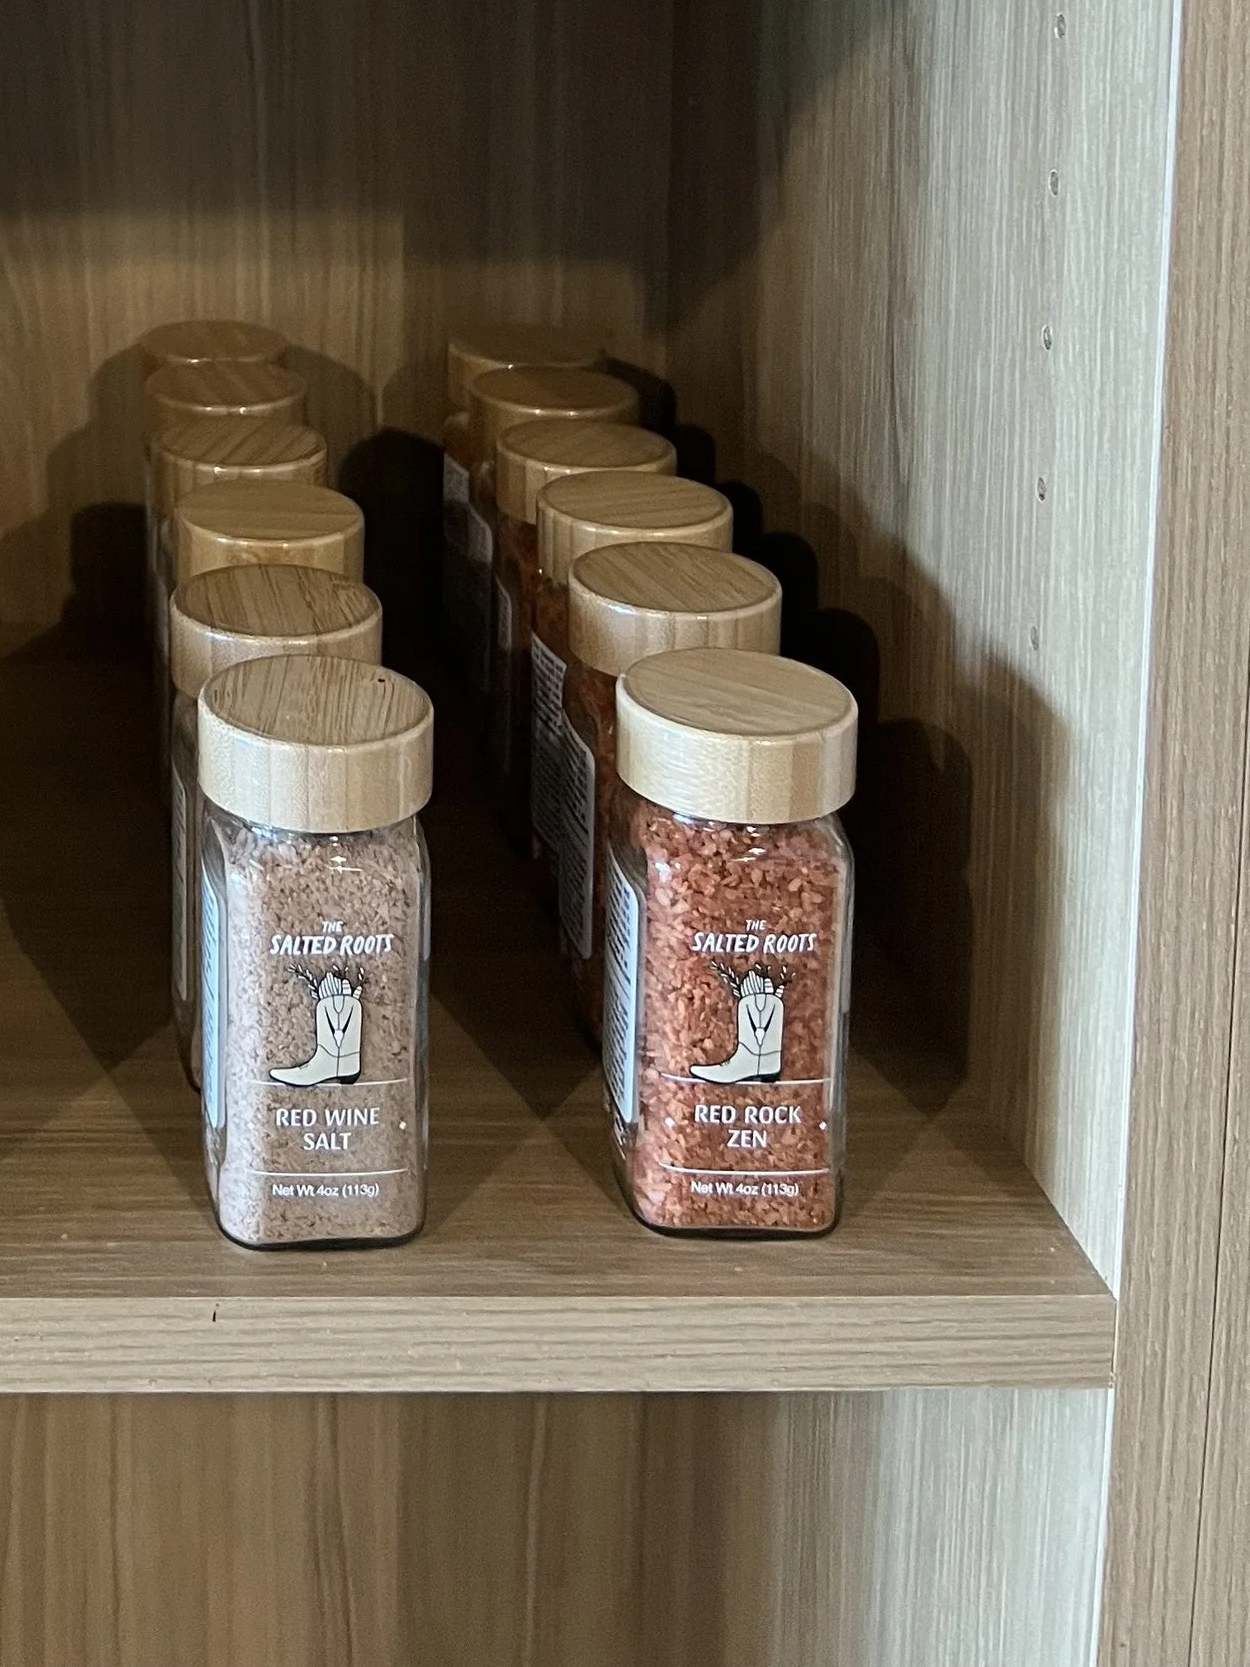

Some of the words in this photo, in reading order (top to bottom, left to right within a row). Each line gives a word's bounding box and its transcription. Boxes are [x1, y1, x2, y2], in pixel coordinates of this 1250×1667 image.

[321, 920, 343, 933] THE
[745, 919, 767, 932] THE
[269, 934, 337, 956] SALTED
[339, 933, 395, 955] ROOTS
[691, 931, 760, 953] SALTED
[762, 932, 818, 954] ROOTS
[275, 1108, 318, 1127] RED
[324, 1106, 381, 1126] WINE
[693, 1104, 737, 1124] RED
[744, 1104, 802, 1124] ROCK
[303, 1132, 352, 1151] SALT
[726, 1129, 768, 1149] ZEN
[271, 1183, 295, 1197] Net
[296, 1183, 316, 1197] Wt
[316, 1184, 340, 1197] 4oz
[342, 1182, 380, 1199] (113g)
[690, 1180, 715, 1194] Net
[715, 1181, 735, 1195] Wt
[735, 1181, 759, 1195] 4oz
[760, 1180, 800, 1197] (113g)
